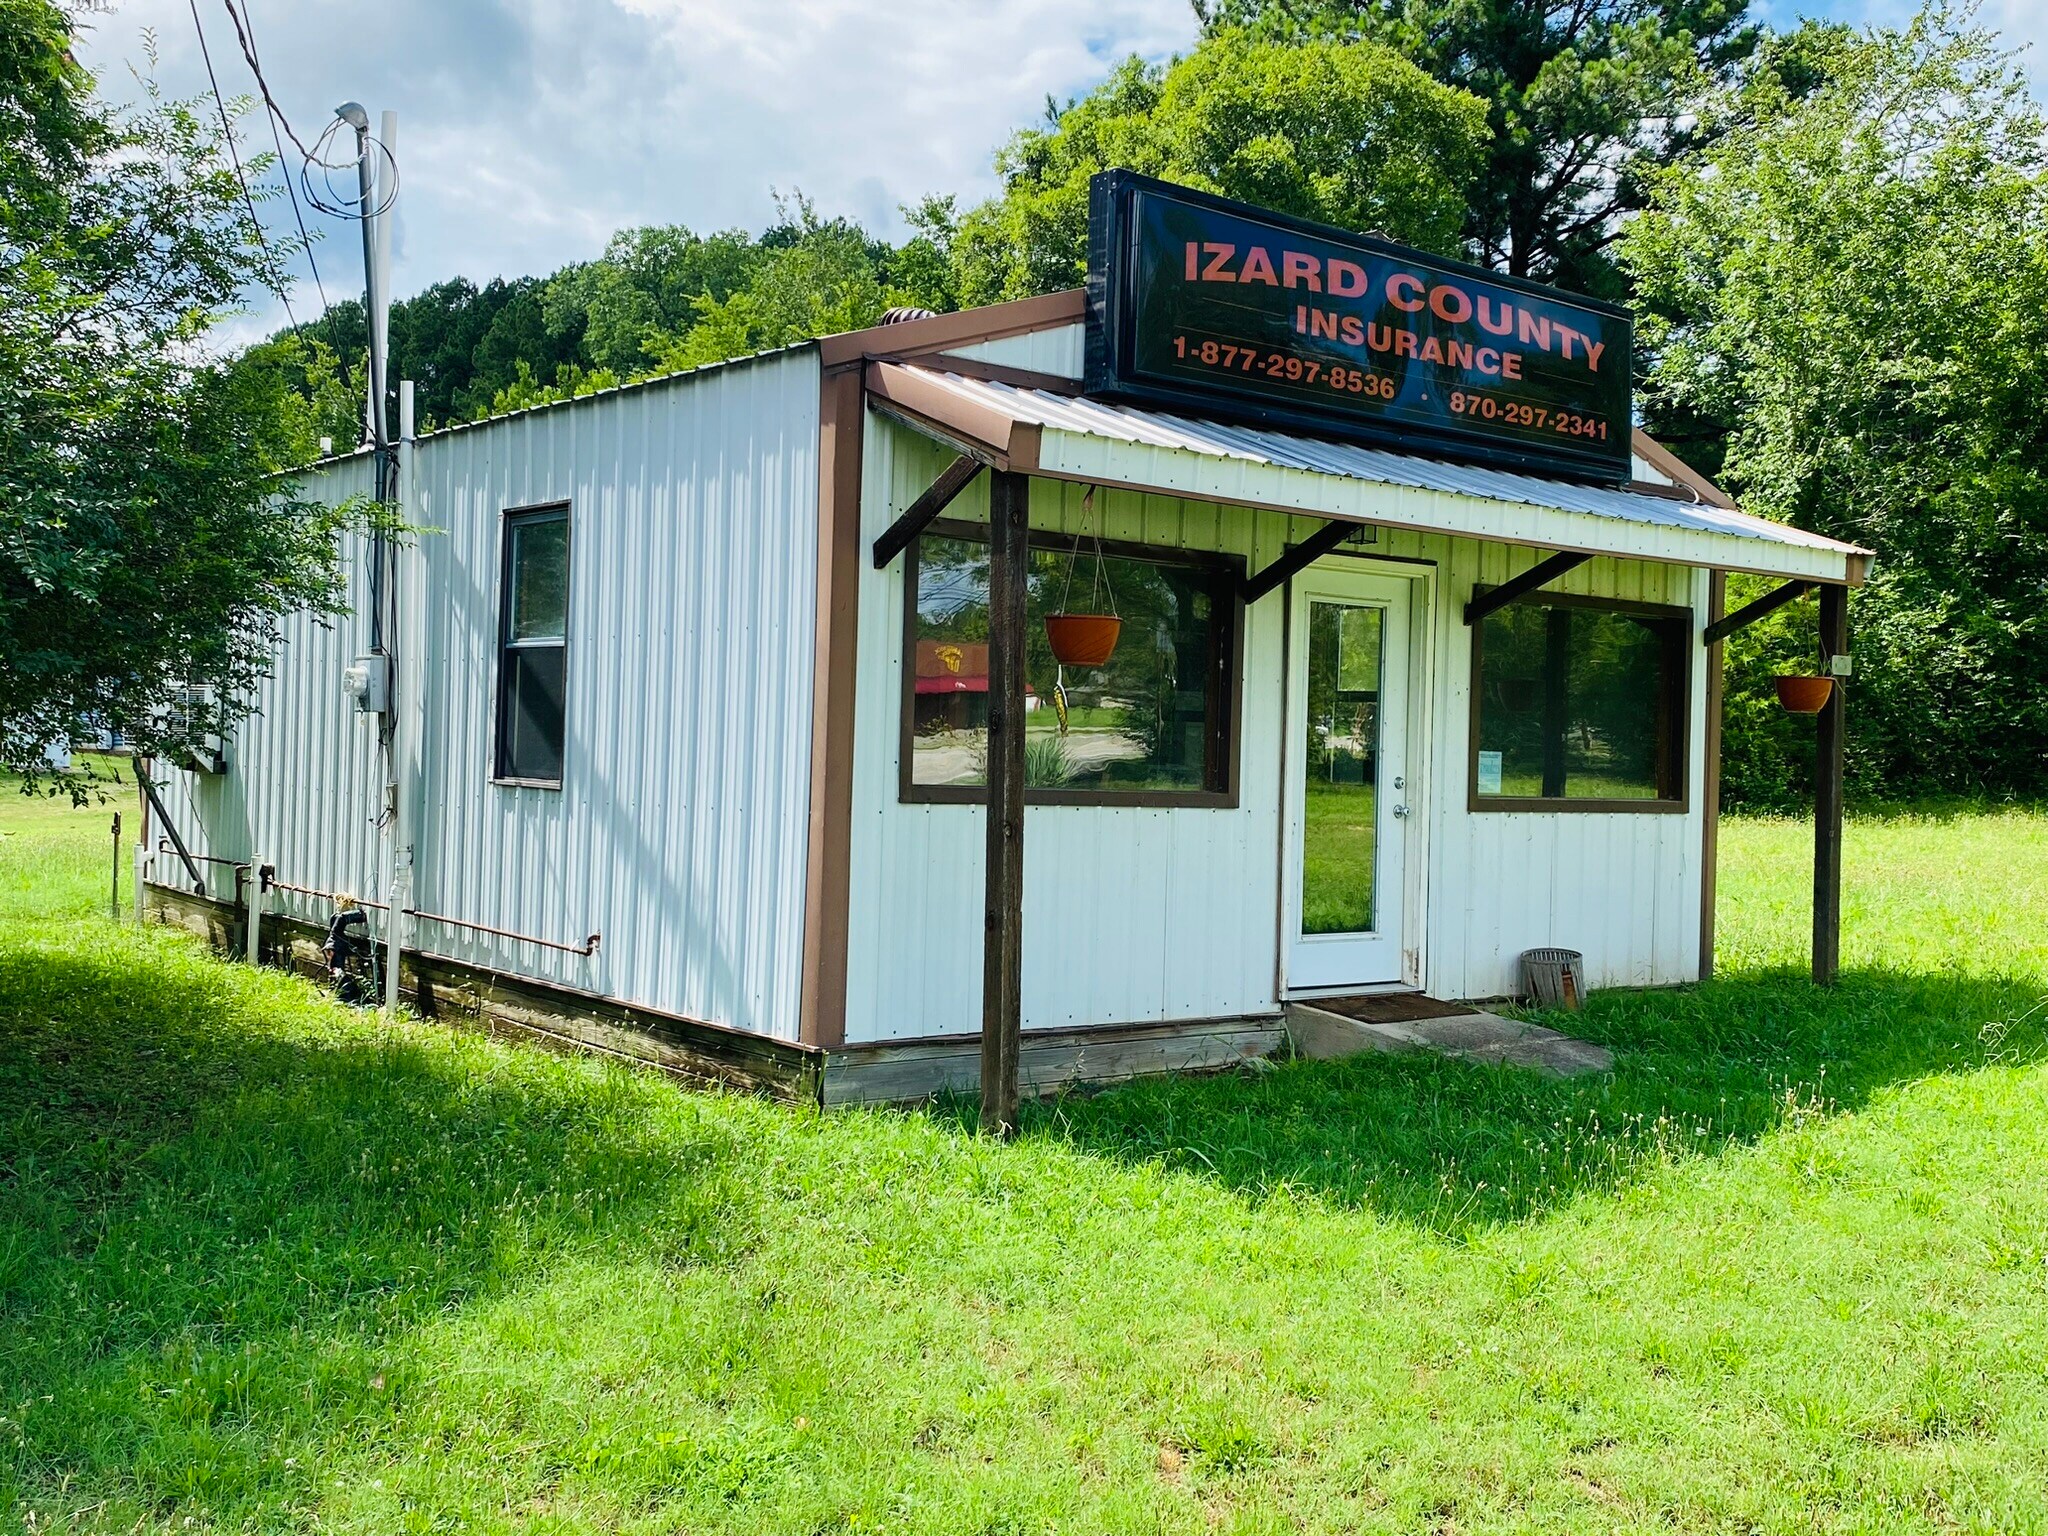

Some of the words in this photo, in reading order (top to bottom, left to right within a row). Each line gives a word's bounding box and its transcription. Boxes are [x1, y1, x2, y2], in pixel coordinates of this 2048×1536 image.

[1185, 242, 1368, 298] IZARD
[1386, 273, 1605, 372] COUNTY
[1297, 306, 1522, 380] INSURANCE
[1173, 337, 1395, 399] 1-877-297-8536
[1451, 392, 1607, 440] 870-297-2341
